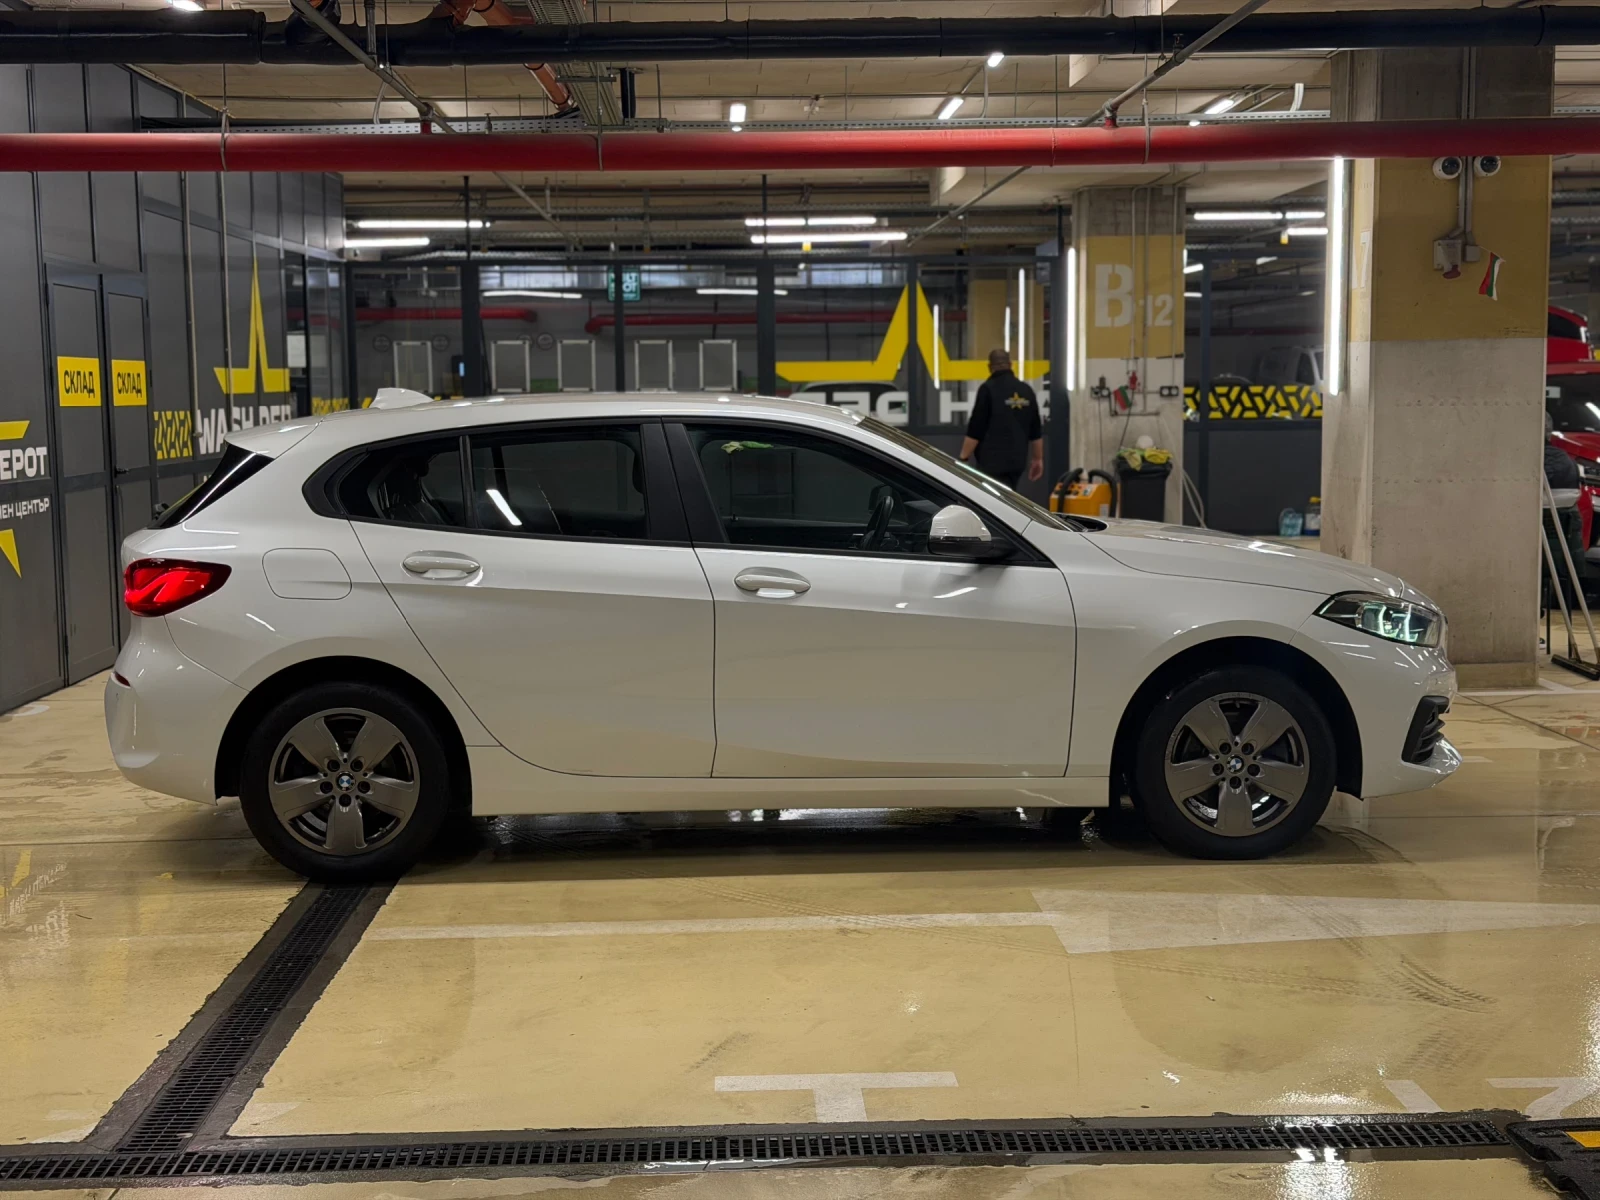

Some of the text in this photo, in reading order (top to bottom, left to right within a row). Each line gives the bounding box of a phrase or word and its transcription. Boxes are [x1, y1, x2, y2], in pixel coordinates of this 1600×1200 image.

[64, 370, 95, 398] СКЛАД
[117, 372, 142, 398] СКЛАД
[15, 498, 50, 519] ЦЕНТЪР
